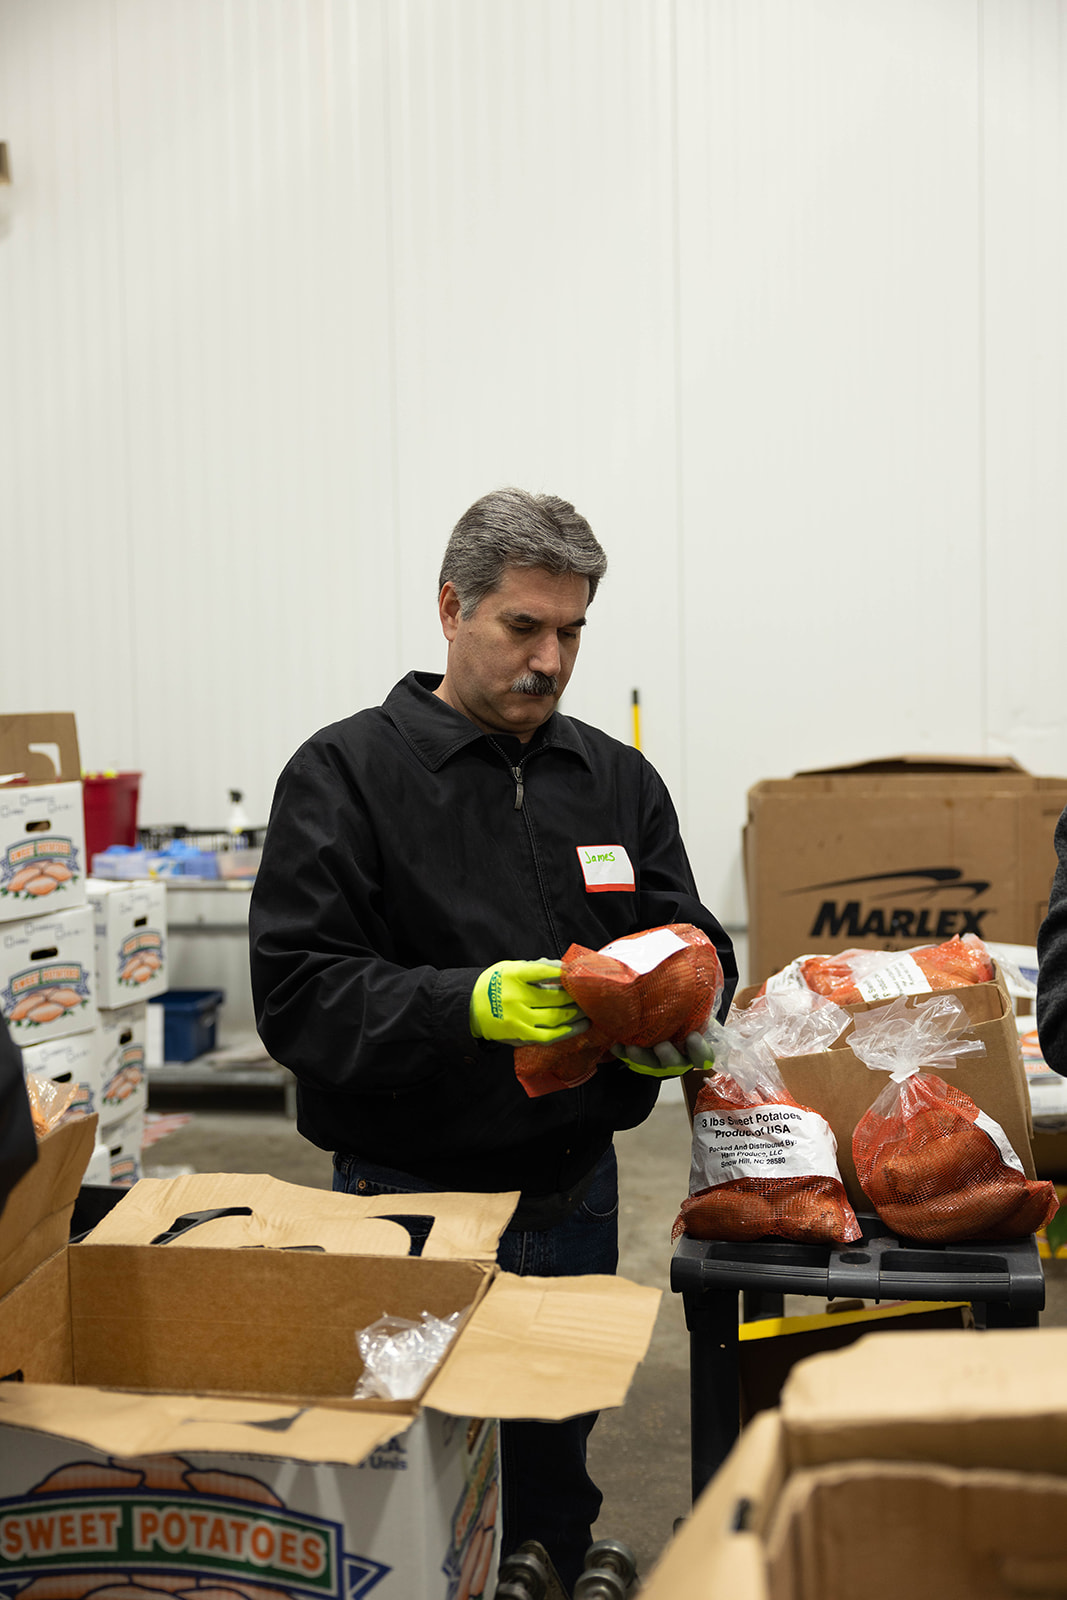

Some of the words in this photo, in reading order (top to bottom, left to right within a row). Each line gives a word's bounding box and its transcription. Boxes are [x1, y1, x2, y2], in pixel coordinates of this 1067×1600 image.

[585, 851, 615, 864] James
[810, 900, 986, 938] MARLEX
[702, 1118, 708, 1128] 3
[710, 1117, 725, 1126] lbs
[756, 1111, 802, 1123] Potatoes
[767, 1123, 791, 1135] USA
[709, 1145, 733, 1153] Packed
[734, 1143, 747, 1151] And
[370, 1456, 408, 1470] Unis
[3, 1512, 119, 1555] SWEET
[139, 1511, 323, 1573] POTATOES
